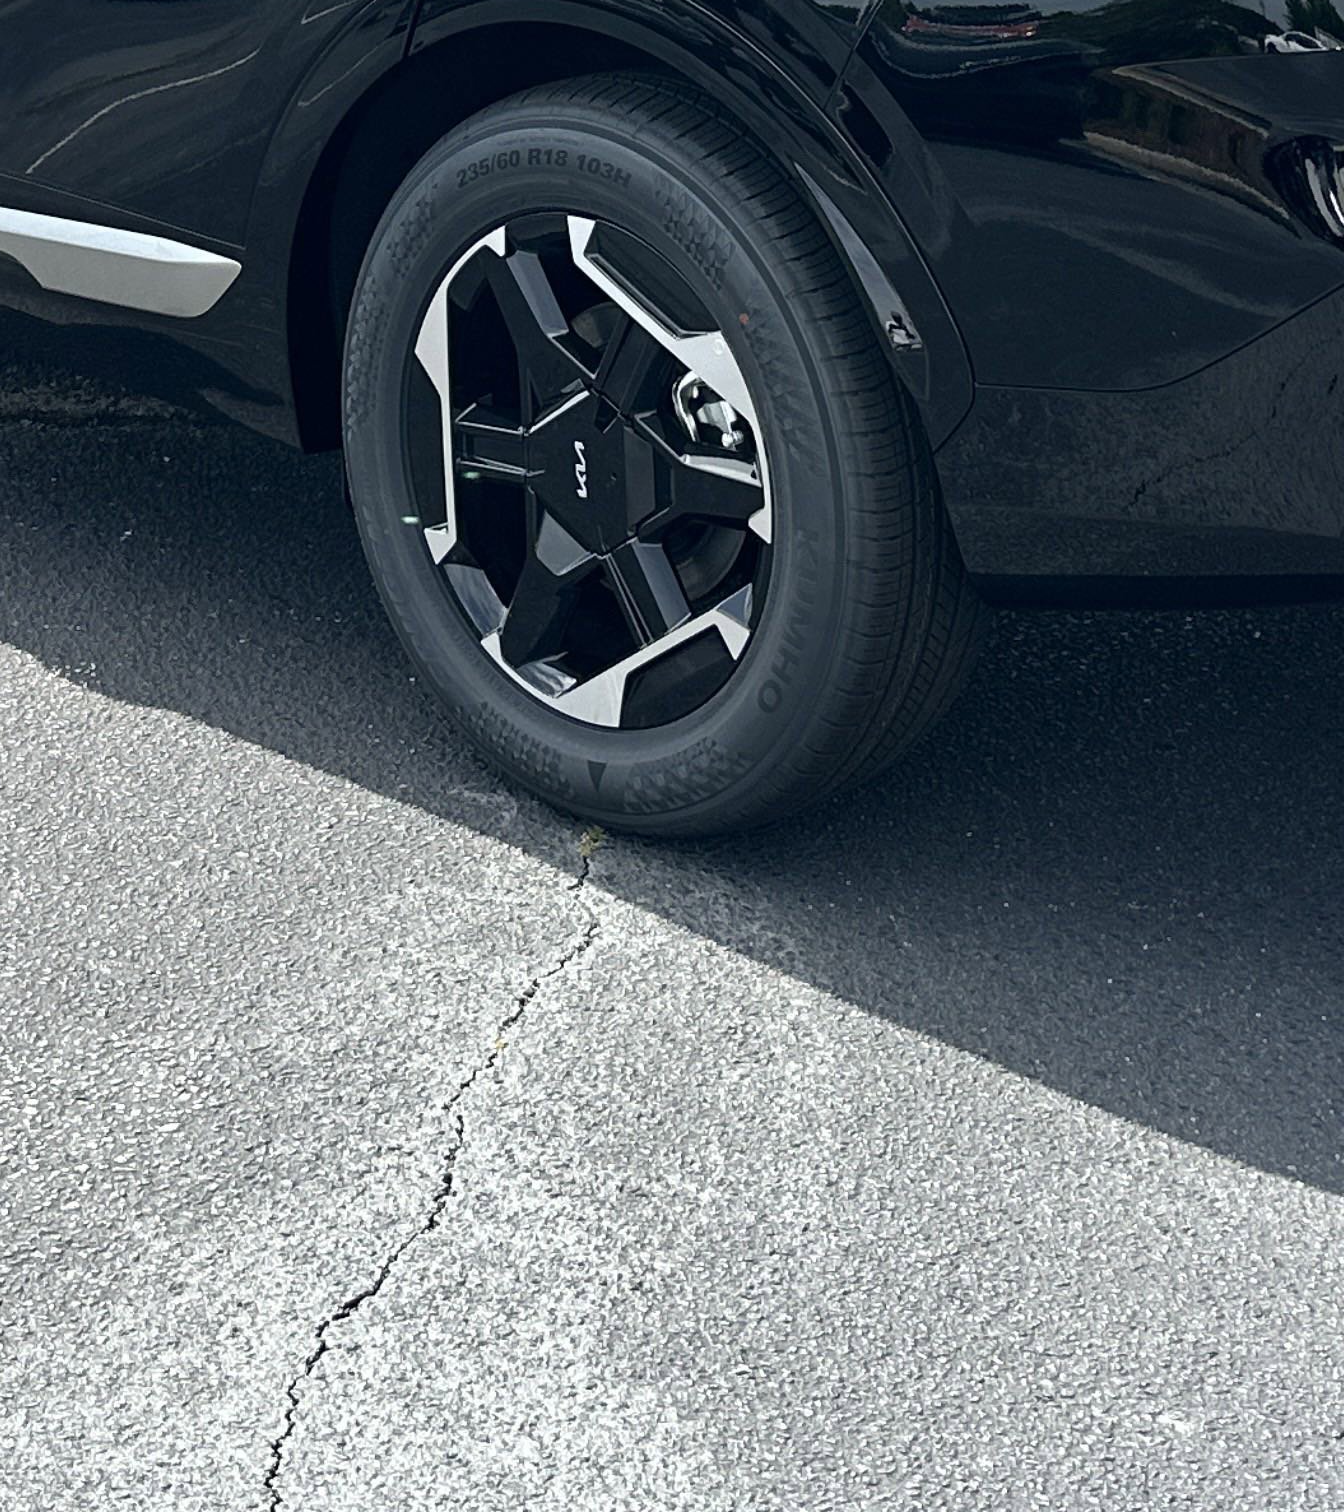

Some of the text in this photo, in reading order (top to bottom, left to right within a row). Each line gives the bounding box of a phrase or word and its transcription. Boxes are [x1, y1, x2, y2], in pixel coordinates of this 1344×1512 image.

[456, 147, 633, 189] 235/60 R18 103H
[574, 440, 588, 499] KIA
